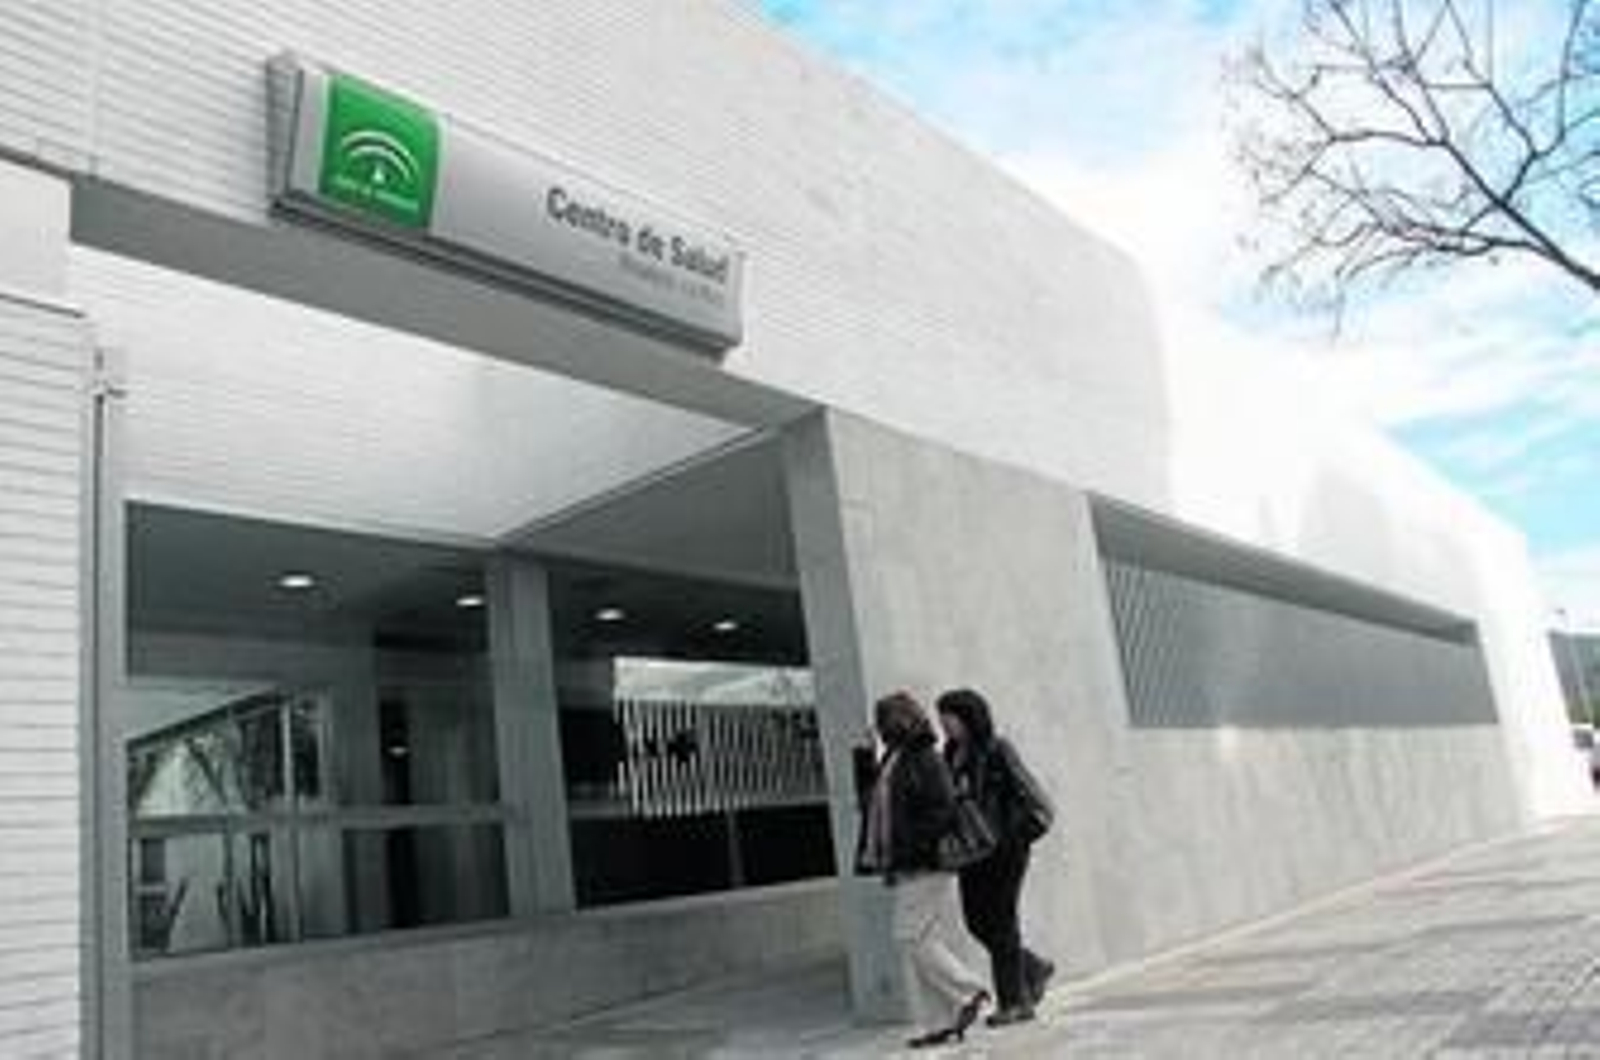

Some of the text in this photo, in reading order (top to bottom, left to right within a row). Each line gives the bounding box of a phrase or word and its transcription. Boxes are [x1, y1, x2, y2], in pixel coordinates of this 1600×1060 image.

[546, 187, 630, 246] Centro
[637, 226, 664, 261] de
[670, 235, 730, 286] Salud
